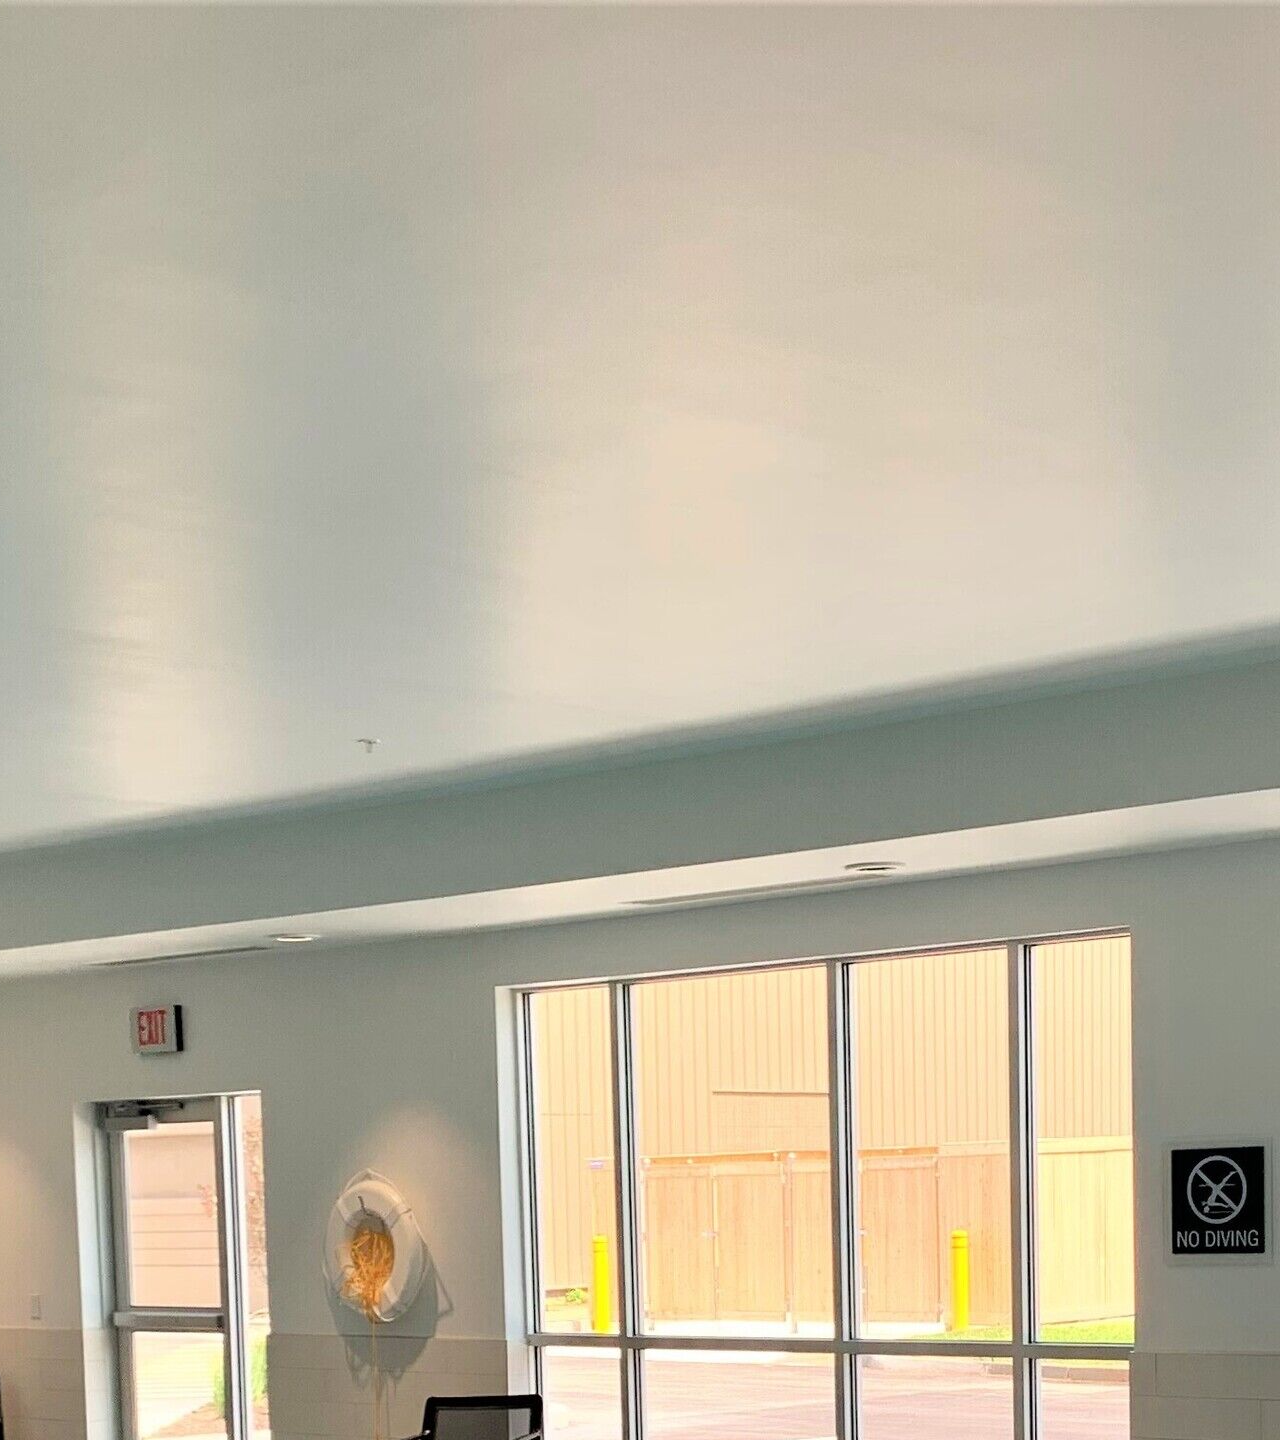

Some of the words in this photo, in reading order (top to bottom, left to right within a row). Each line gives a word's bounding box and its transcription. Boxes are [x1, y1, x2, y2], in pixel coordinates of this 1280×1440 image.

[138, 1010, 166, 1045] EXIT
[1177, 1230, 1200, 1248] NO
[1205, 1229, 1259, 1248] DIVING
